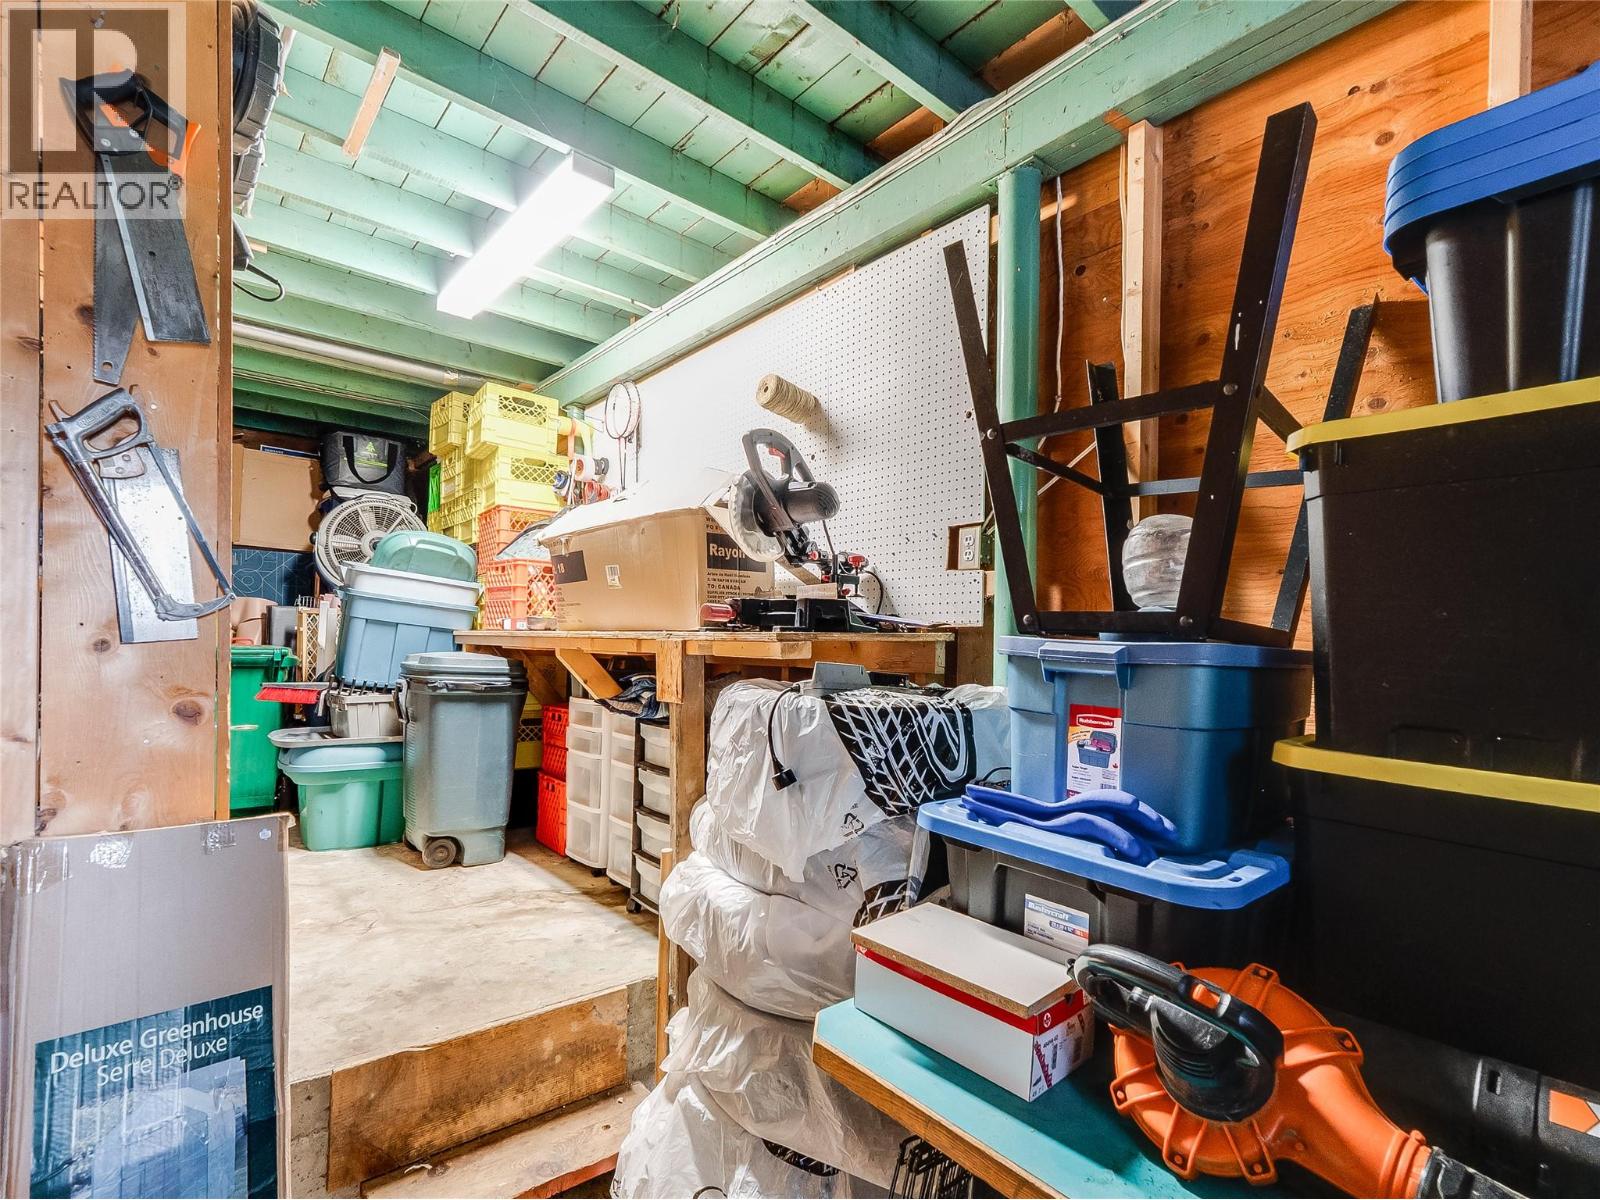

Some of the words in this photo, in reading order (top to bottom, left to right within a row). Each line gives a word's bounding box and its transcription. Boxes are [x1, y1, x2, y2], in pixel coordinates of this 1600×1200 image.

[709, 543, 746, 560] Rayon
[1078, 717, 1113, 727] Rubbermaid
[51, 1038, 133, 1075] Deluxe
[140, 1004, 264, 1049] Greenhouse
[96, 1057, 152, 1088] Serre
[160, 1036, 228, 1070] Deluxe
